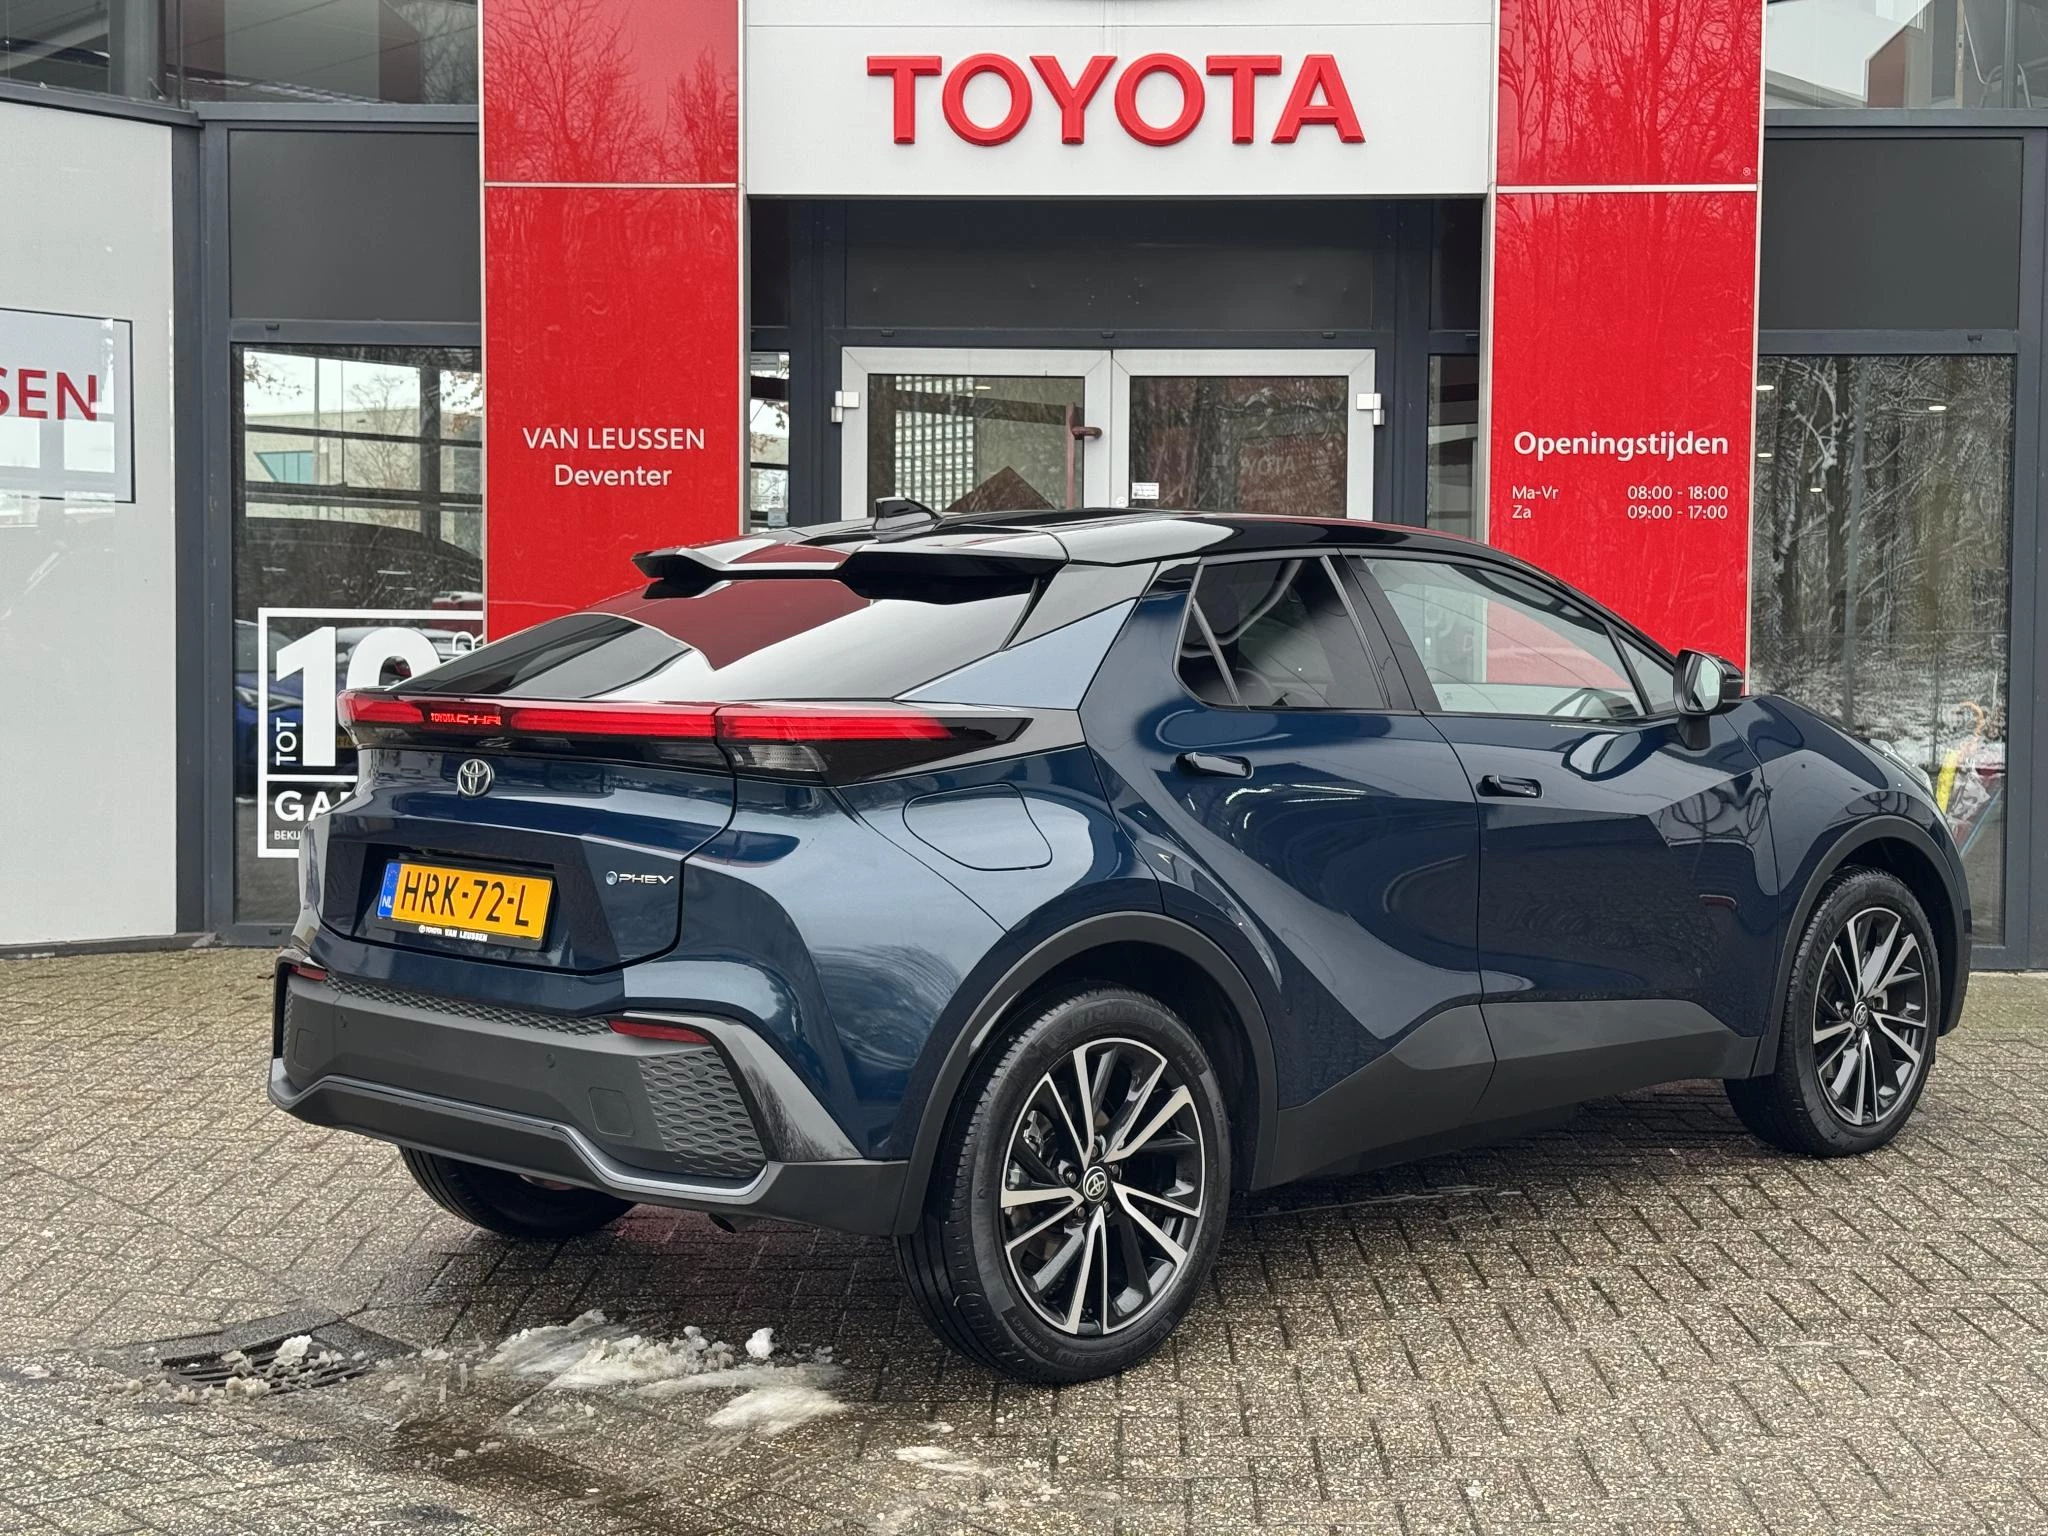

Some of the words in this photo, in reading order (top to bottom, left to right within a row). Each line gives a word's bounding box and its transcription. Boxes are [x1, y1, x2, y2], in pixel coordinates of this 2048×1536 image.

[867, 52, 1366, 147] TOYOTA
[522, 427, 579, 449] VAN
[588, 427, 705, 450] LEUSSEN
[1513, 430, 1729, 462] Openingstijden
[554, 463, 673, 487] Deventer
[1511, 485, 1559, 500] Ma-Vr
[1627, 485, 1673, 500] 08:00
[1687, 485, 1729, 500] 18:00
[1511, 504, 1532, 519] Za
[1627, 504, 1673, 519] 09:00
[1687, 504, 1729, 519] 17:00
[431, 712, 456, 723] TOYOTA
[275, 717, 298, 766] TOT
[619, 873, 675, 884] PHEV
[381, 897, 393, 909] NL
[400, 871, 530, 928] HRK-72-L
[444, 928, 457, 938] VAN
